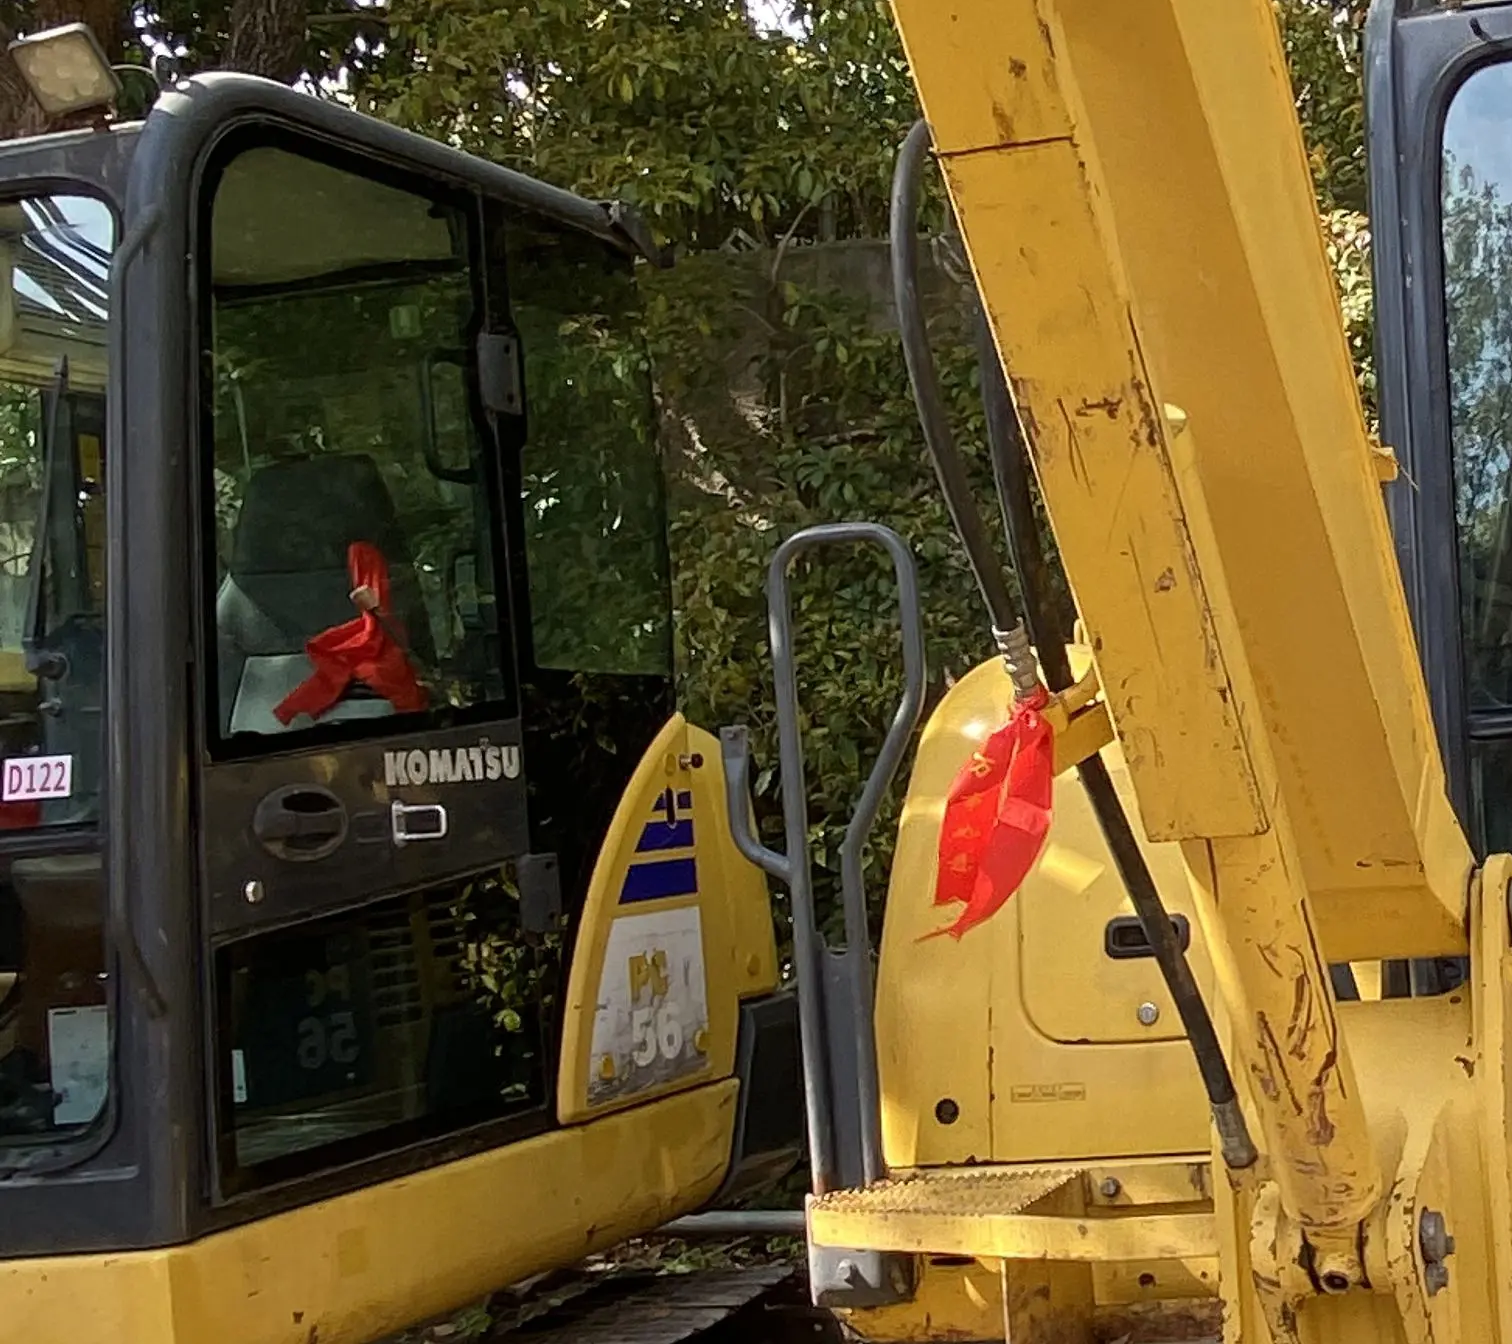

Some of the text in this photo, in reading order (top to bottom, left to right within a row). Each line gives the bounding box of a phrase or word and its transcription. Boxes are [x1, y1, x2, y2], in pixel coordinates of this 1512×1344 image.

[7, 761, 66, 795] D122
[384, 744, 520, 786] KOMATSU
[632, 1002, 684, 1067] 56
